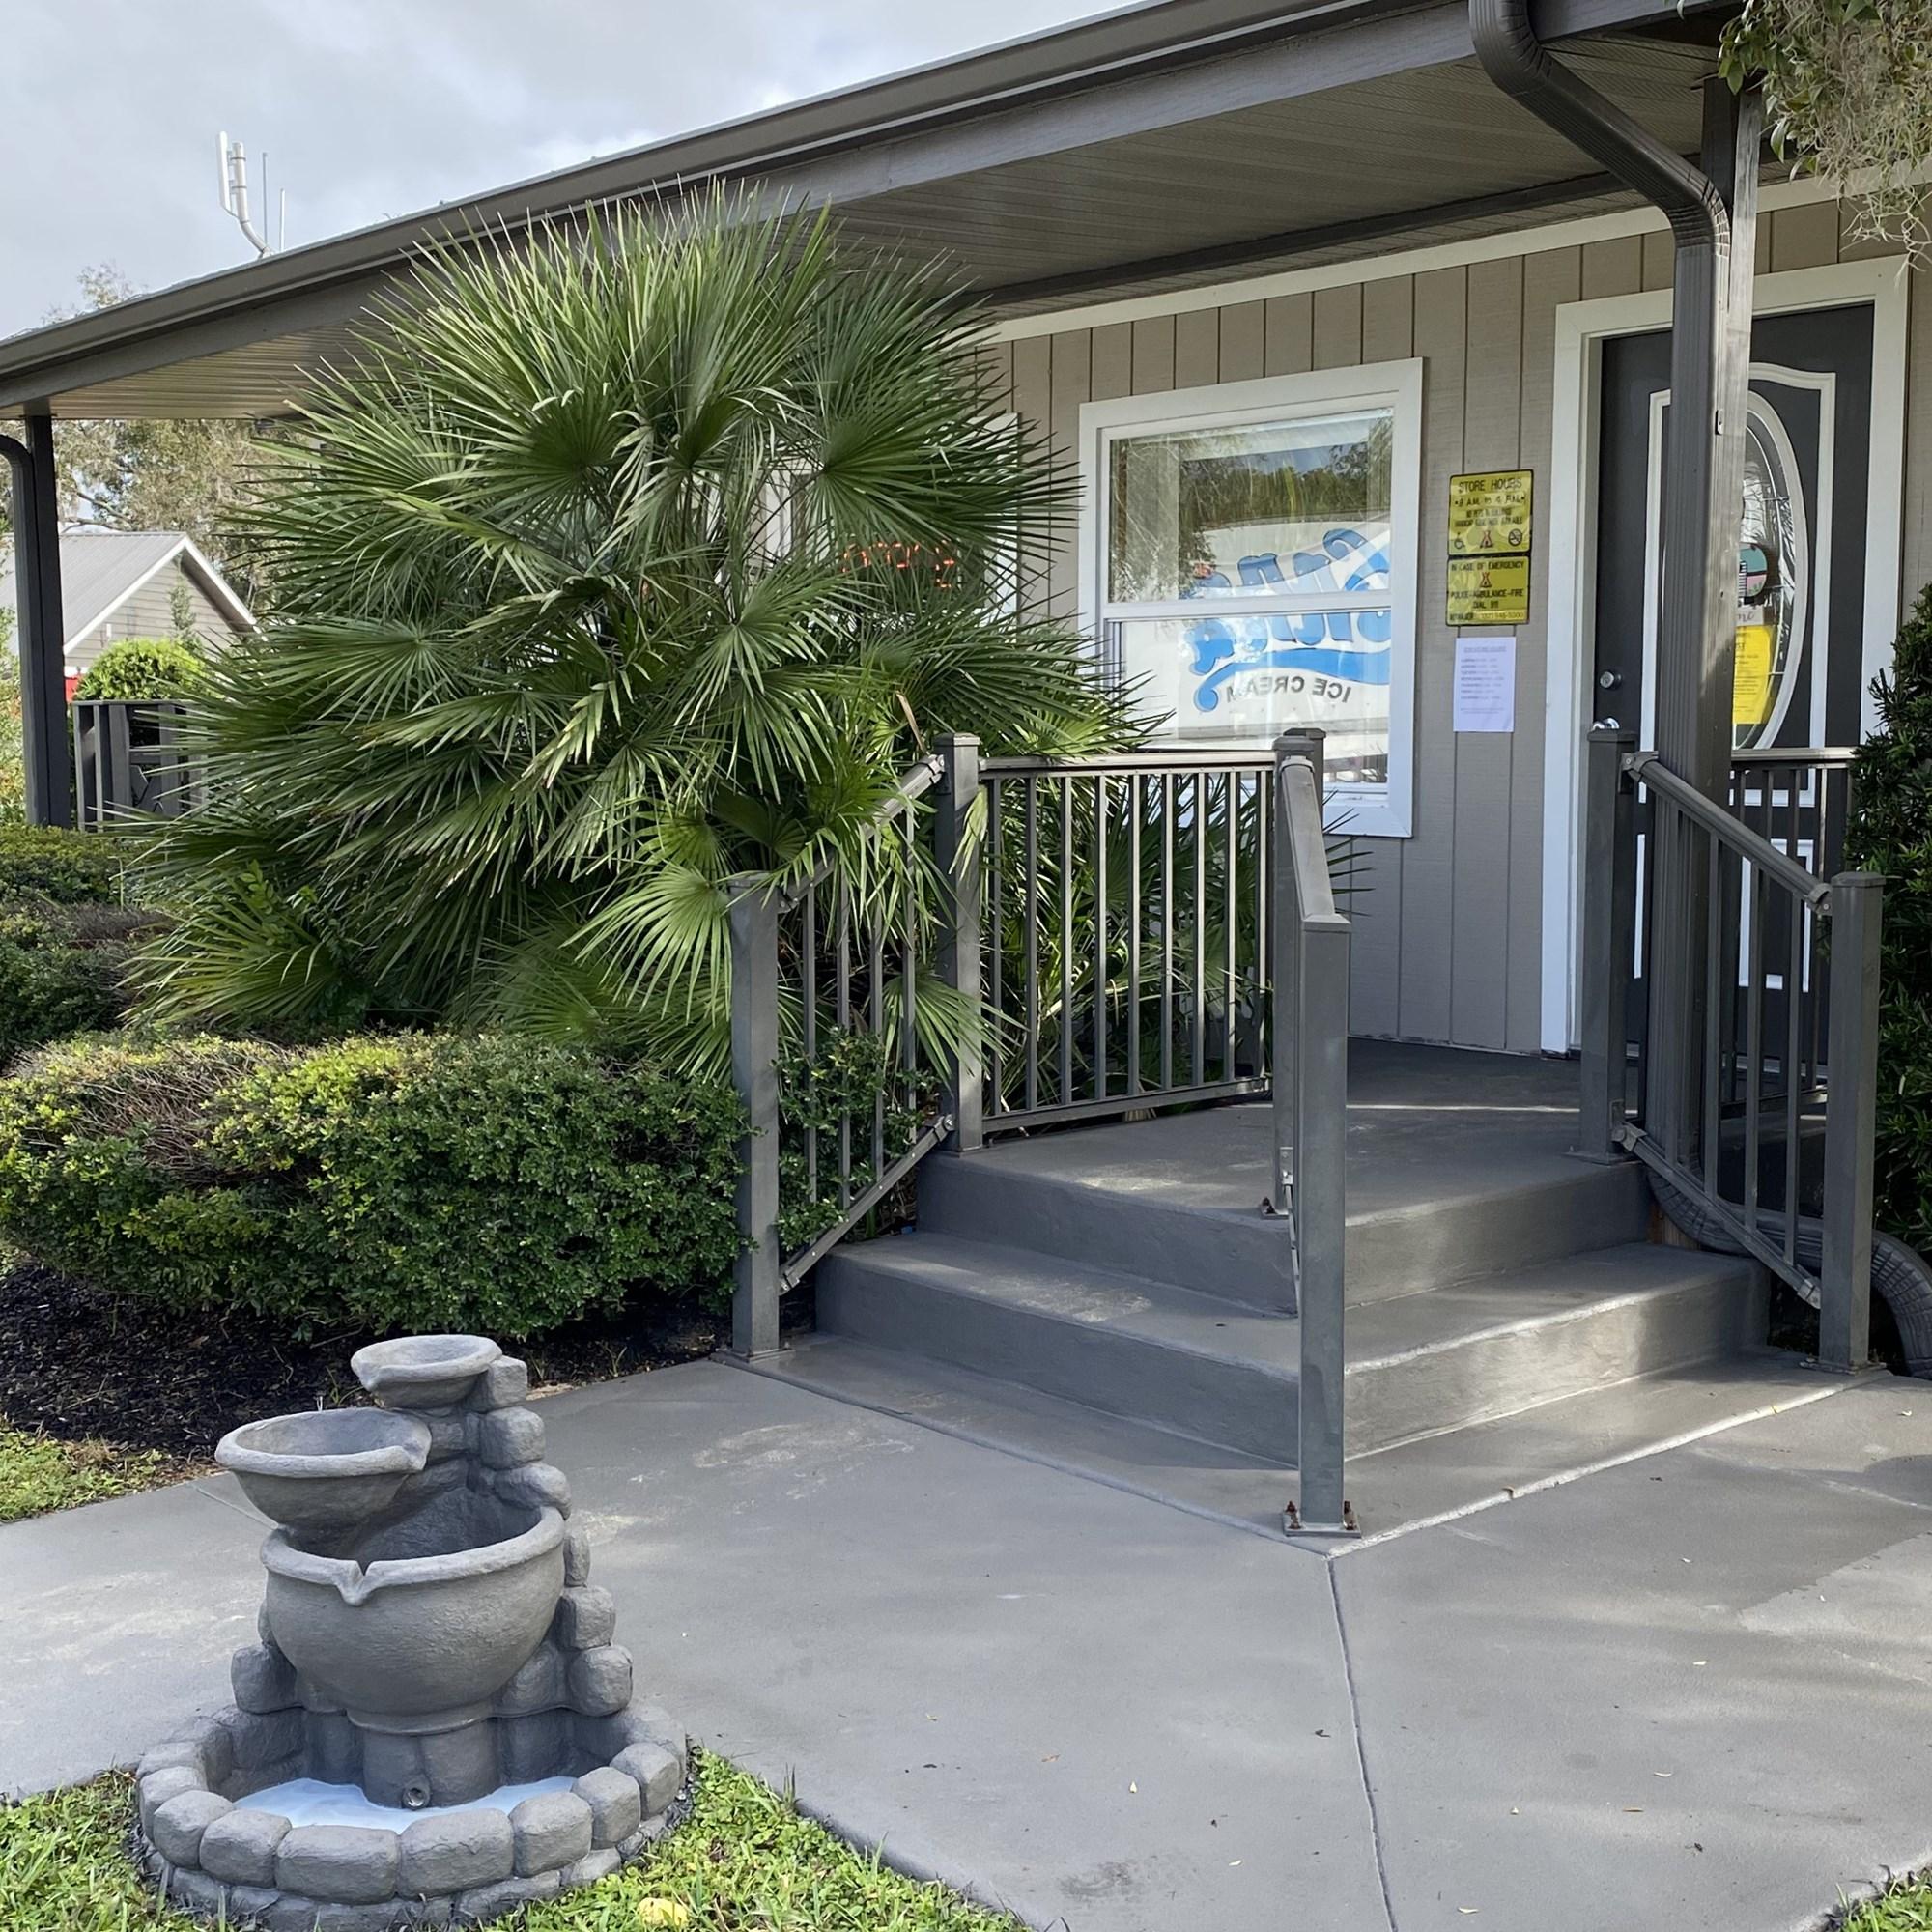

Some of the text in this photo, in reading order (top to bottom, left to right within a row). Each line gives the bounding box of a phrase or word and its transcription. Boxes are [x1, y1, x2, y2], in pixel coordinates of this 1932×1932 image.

[1459, 477, 1522, 494] STORE HOURS
[1488, 560, 1524, 570] EMERGENCY
